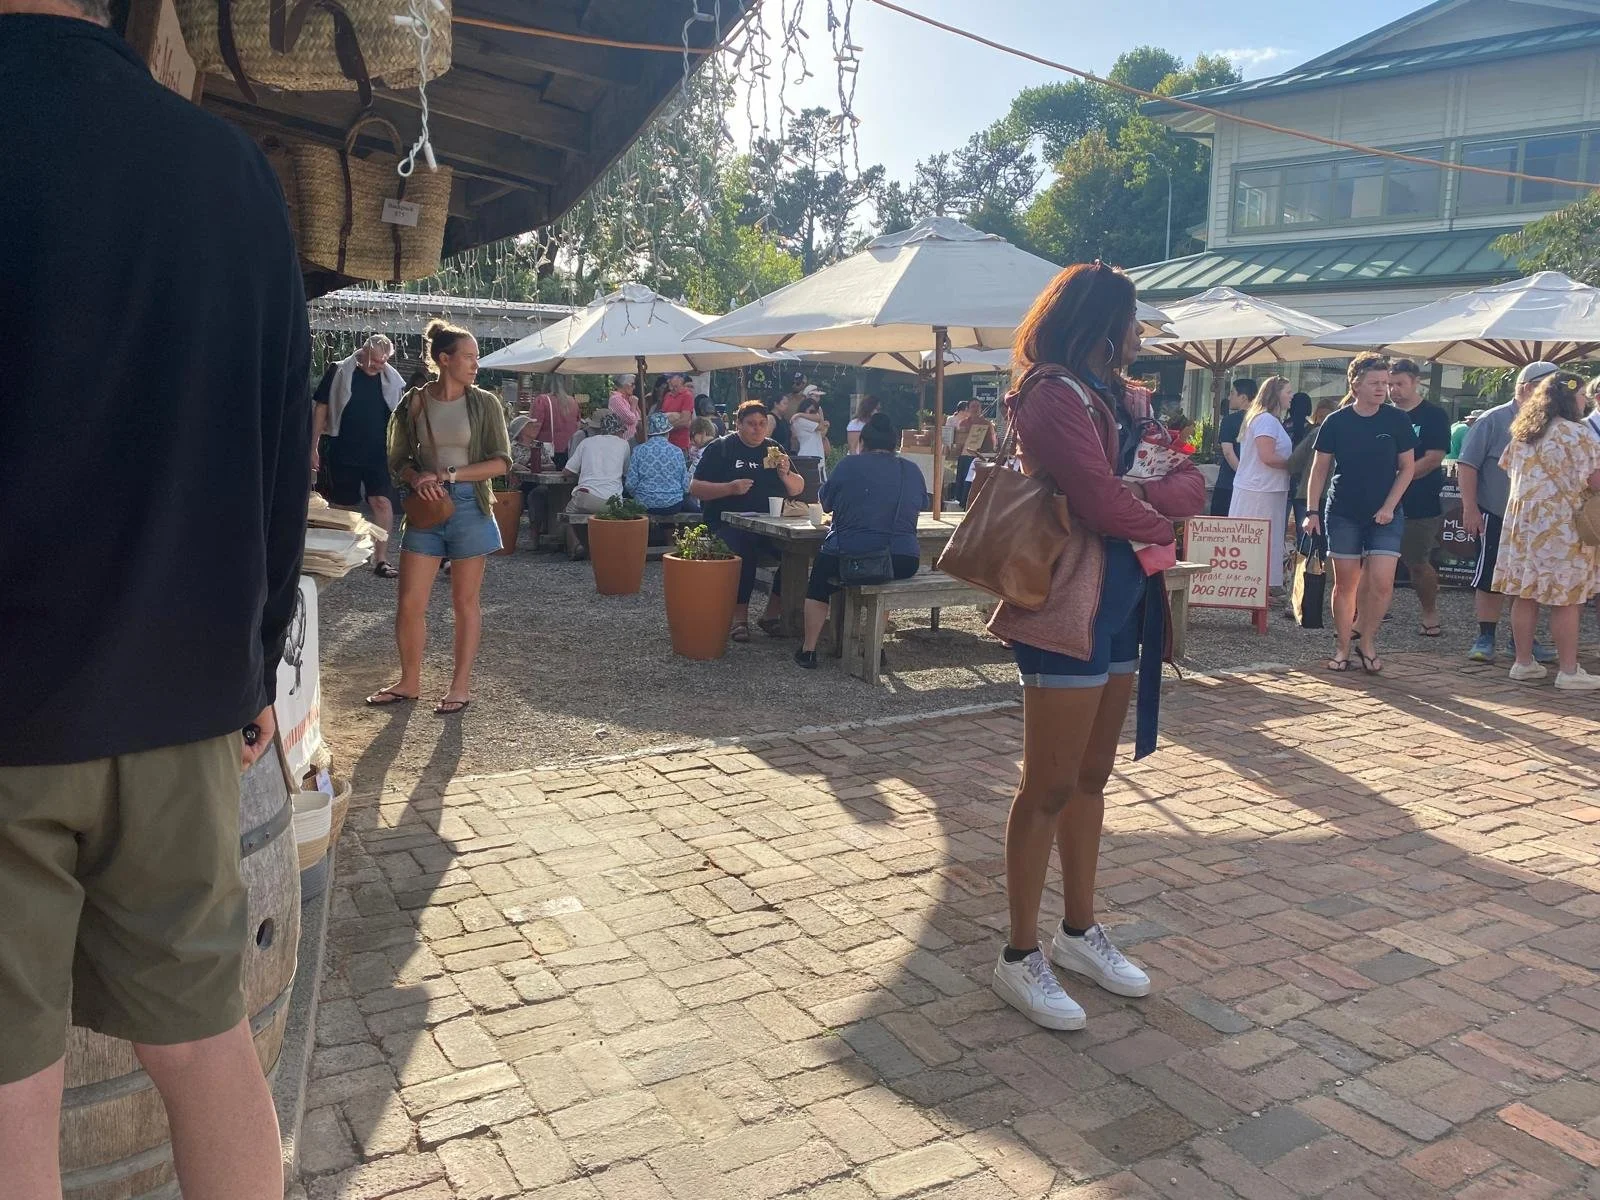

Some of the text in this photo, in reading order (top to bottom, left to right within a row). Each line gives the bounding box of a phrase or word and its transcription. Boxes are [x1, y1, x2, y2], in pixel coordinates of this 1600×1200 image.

[1231, 534, 1262, 545] Market
[1214, 546, 1241, 558] NO
[1209, 559, 1248, 570] DOGS
[1192, 584, 1258, 599] DOG SITTER
